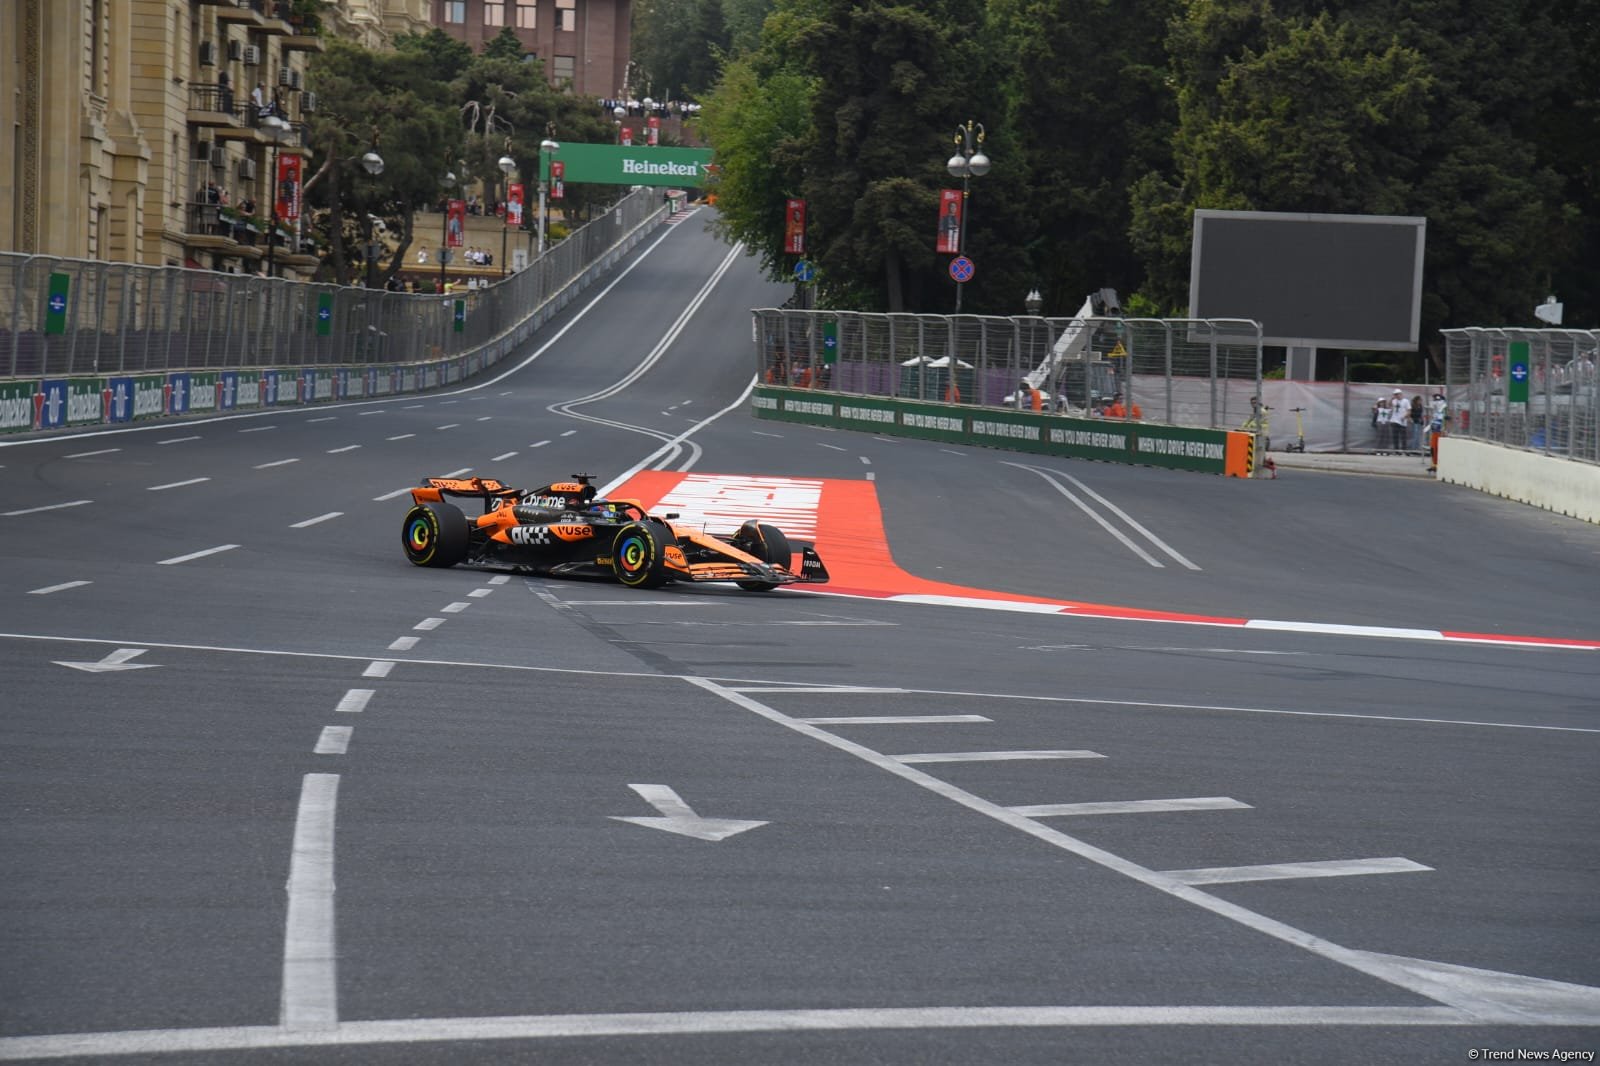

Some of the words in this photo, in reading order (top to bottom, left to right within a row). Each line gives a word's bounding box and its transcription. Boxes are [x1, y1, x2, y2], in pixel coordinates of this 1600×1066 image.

[622, 159, 696, 176] Heineken
[67, 385, 100, 421] Heineken
[134, 381, 162, 416] Heineken
[1050, 428, 1064, 443] WHEN
[1065, 430, 1075, 444] YOU
[1076, 431, 1091, 446] DRIVE
[1092, 432, 1108, 447] NEVER
[1109, 434, 1126, 450] DRINK
[1138, 437, 1154, 453] WHEN
[1156, 439, 1167, 454] YOU
[1168, 440, 1185, 456] DRIVE
[1185, 442, 1204, 458] NEVER
[1205, 443, 1224, 460] DRINK
